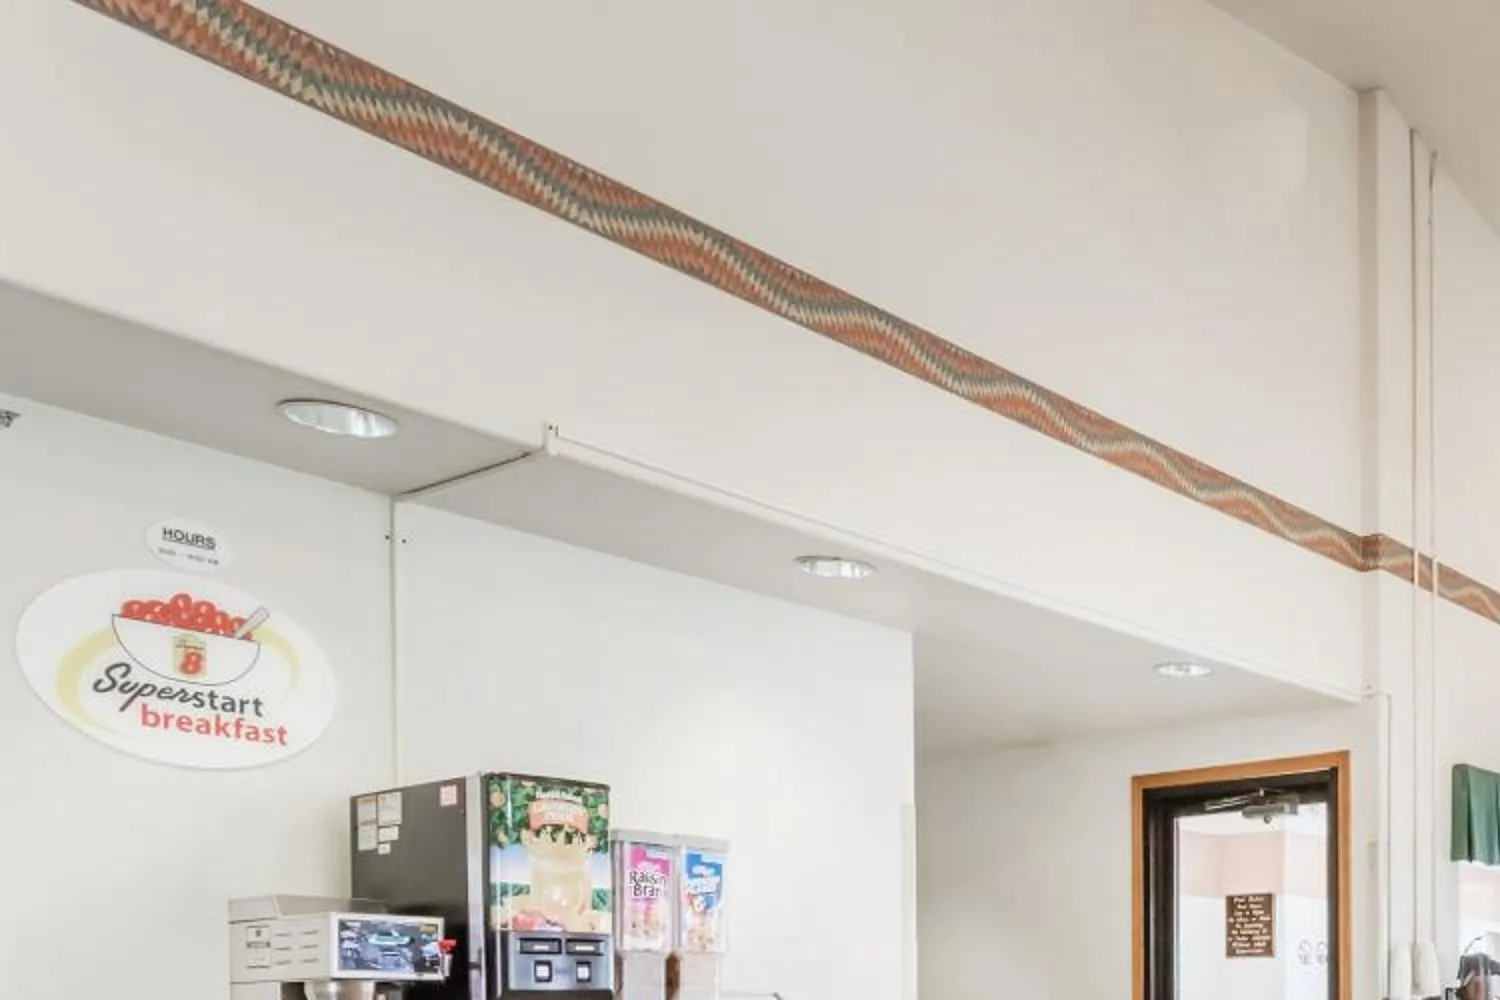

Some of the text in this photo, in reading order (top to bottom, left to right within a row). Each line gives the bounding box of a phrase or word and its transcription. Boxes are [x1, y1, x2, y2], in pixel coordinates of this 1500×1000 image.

[162, 527, 216, 549] HOURS
[179, 652, 204, 674] 8
[92, 662, 263, 716] Superstart
[141, 703, 287, 746] breakfast
